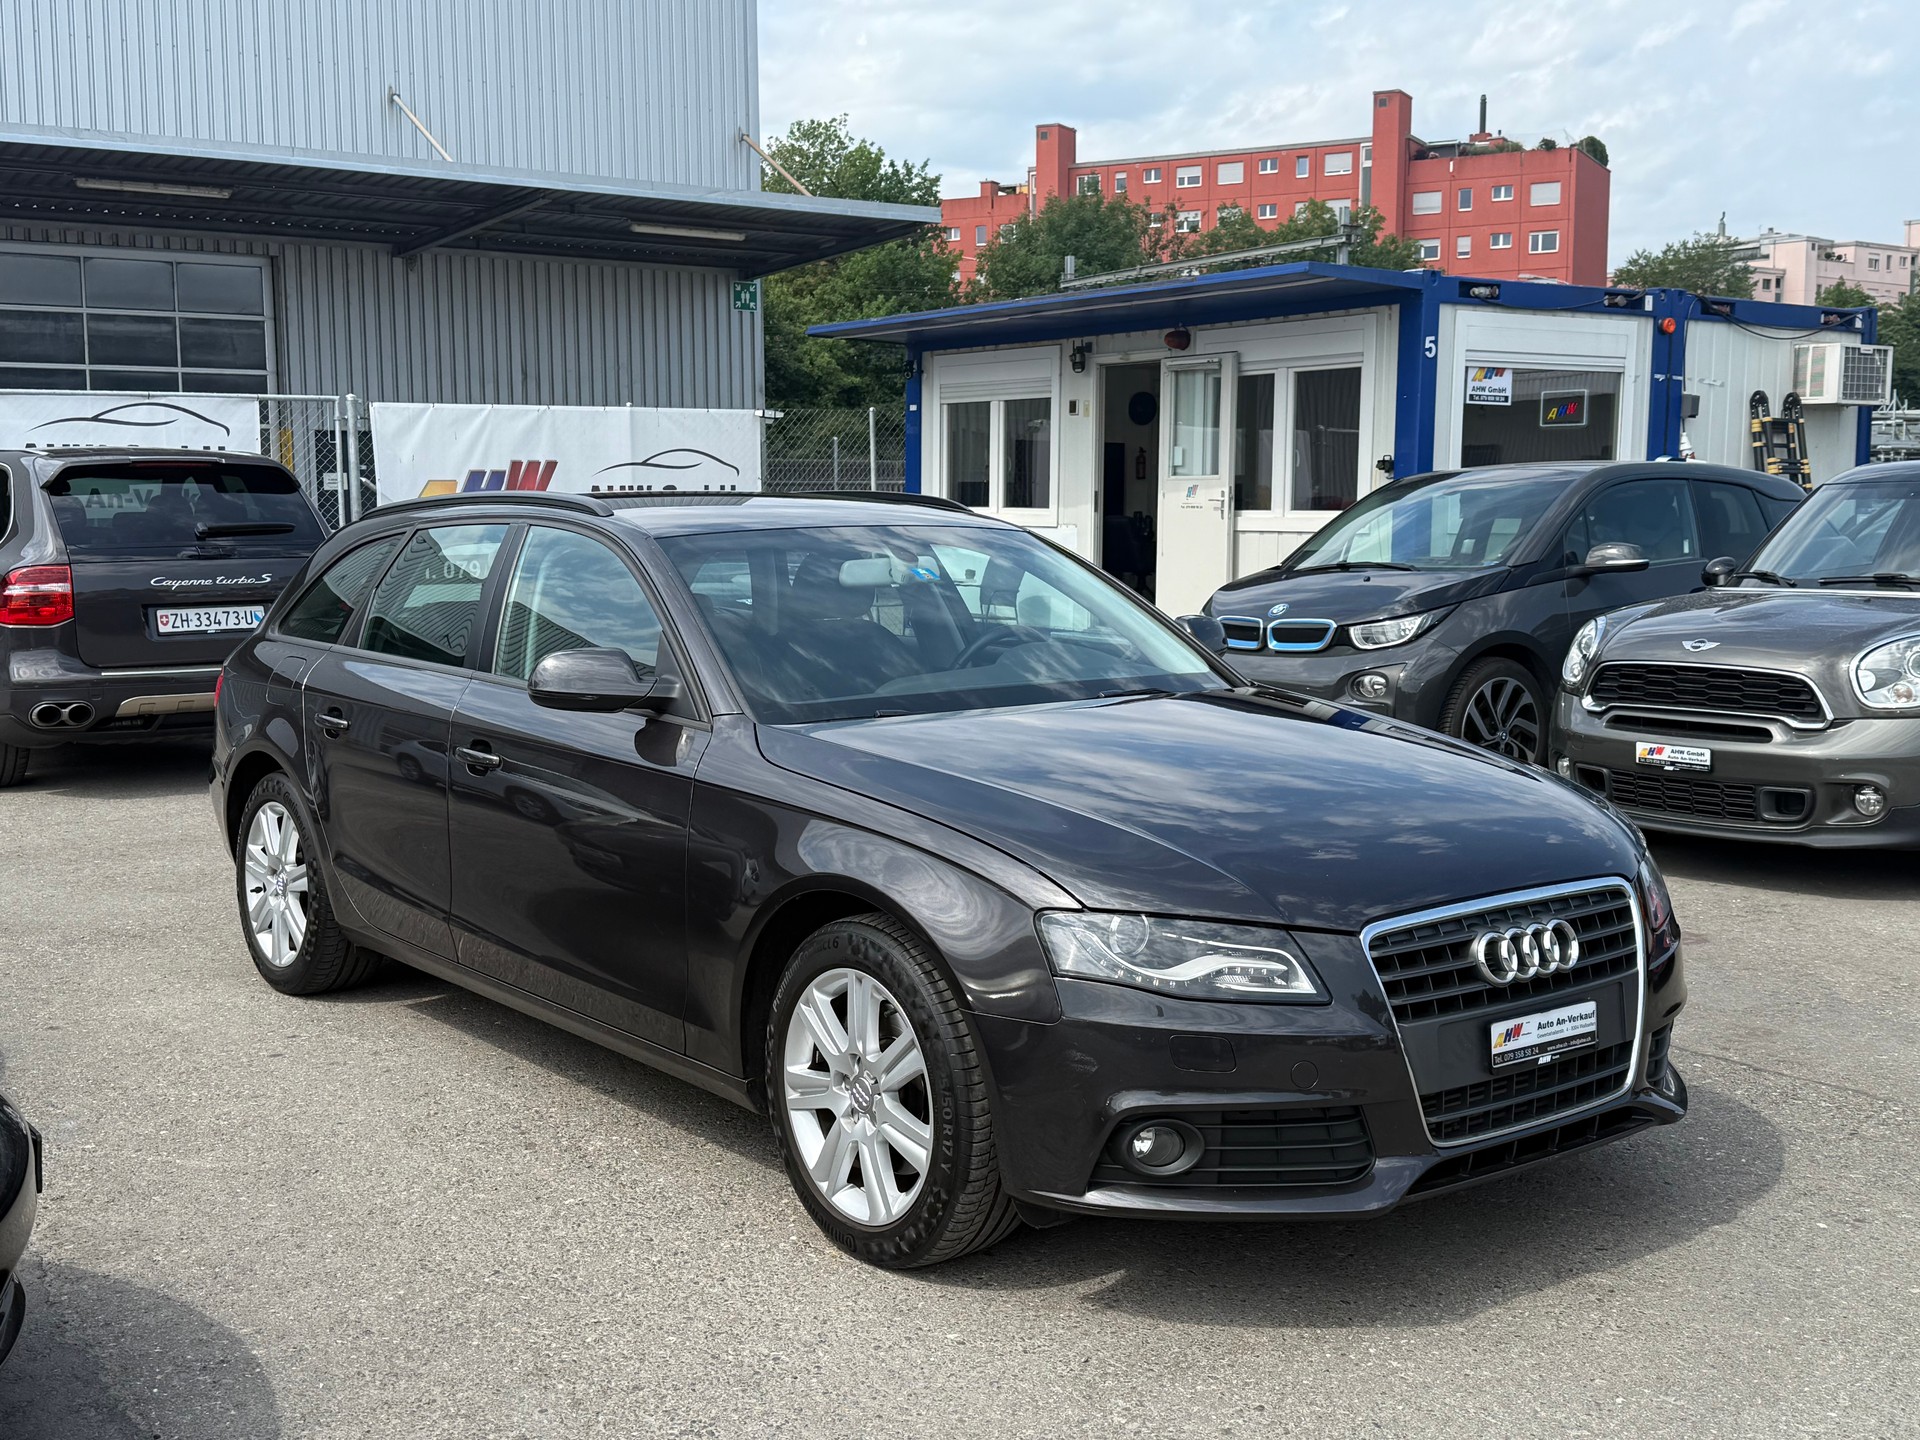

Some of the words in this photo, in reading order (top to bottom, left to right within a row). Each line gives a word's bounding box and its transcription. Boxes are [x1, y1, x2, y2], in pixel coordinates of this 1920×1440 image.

[1425, 336, 1436, 358] 5
[1547, 402, 1578, 420] AHW
[150, 576, 214, 591] Cayenne
[215, 575, 257, 585] turbo
[255, 573, 273, 584] S
[1536, 1021, 1554, 1031] Auto
[1556, 1010, 1595, 1025] An-Verkauf
[1493, 1022, 1524, 1049] AHW
[1494, 1055, 1502, 1064] Tel.
[1503, 1052, 1514, 1062] 079
[1514, 1050, 1524, 1060] 358
[1524, 1048, 1532, 1057] 58
[1532, 1046, 1539, 1055] 24
